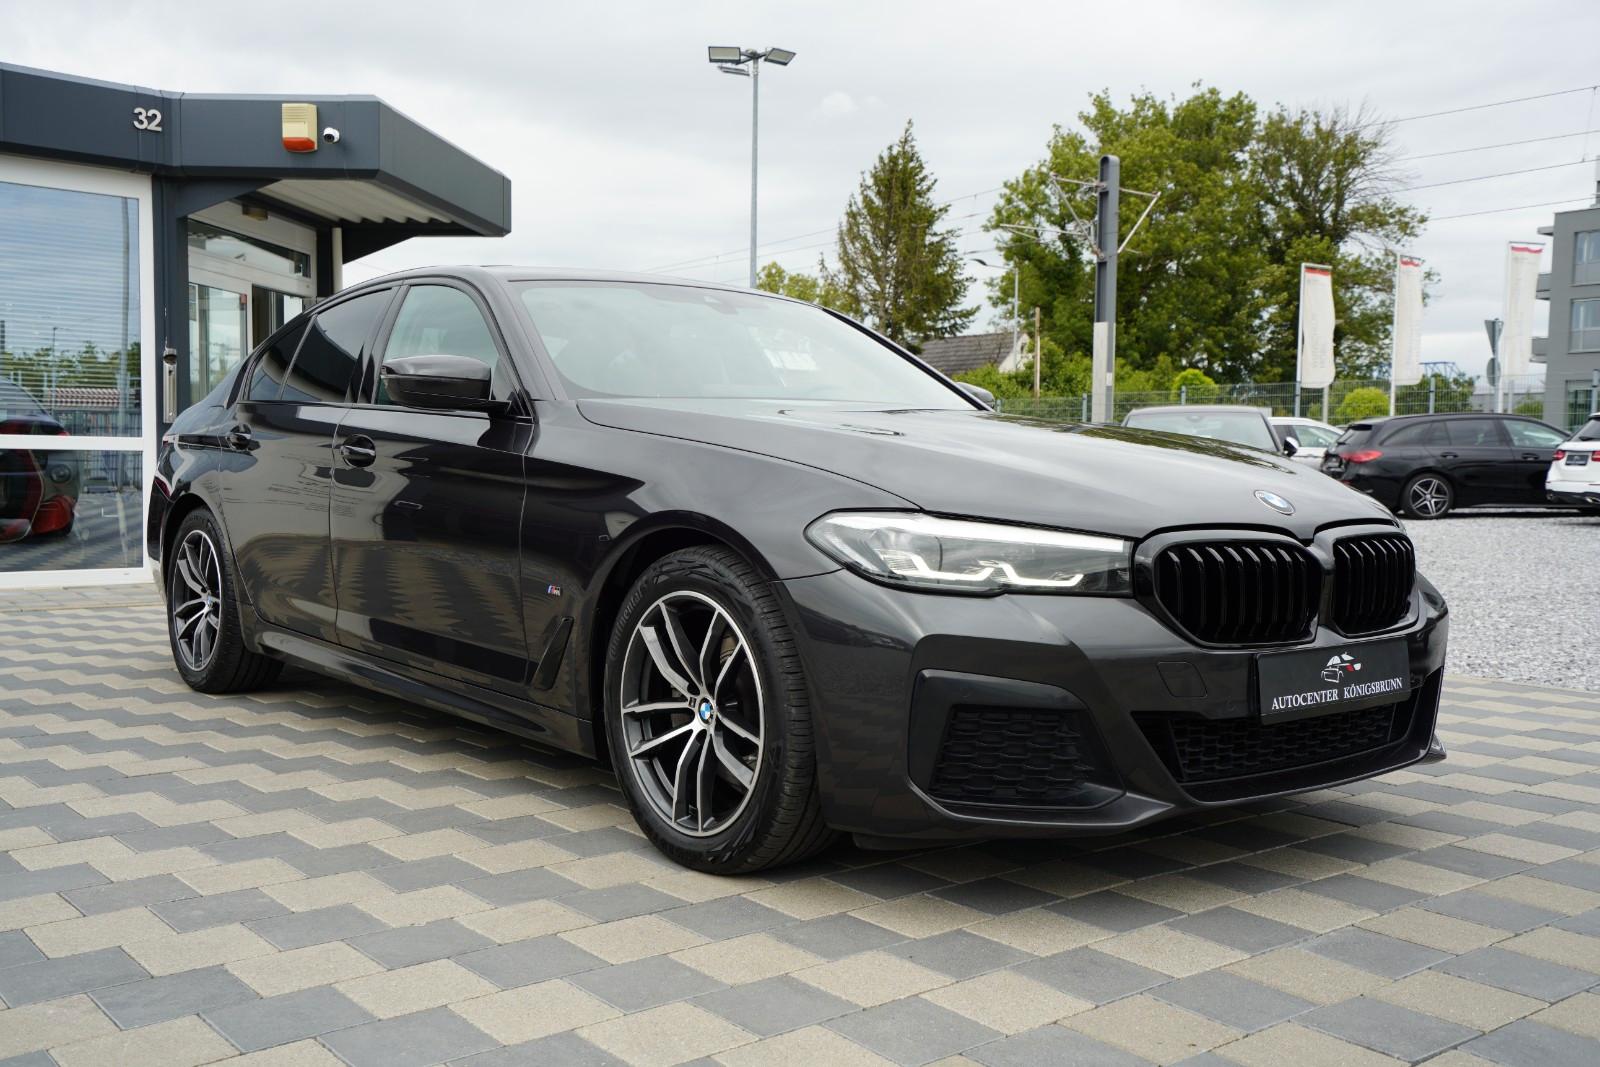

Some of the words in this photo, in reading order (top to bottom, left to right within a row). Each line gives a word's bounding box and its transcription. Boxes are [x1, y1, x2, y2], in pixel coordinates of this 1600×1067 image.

[133, 107, 162, 132] 32
[1271, 688, 1339, 710] AUTOCENTER
[1343, 677, 1403, 699] KÖNIGSBRUNN
